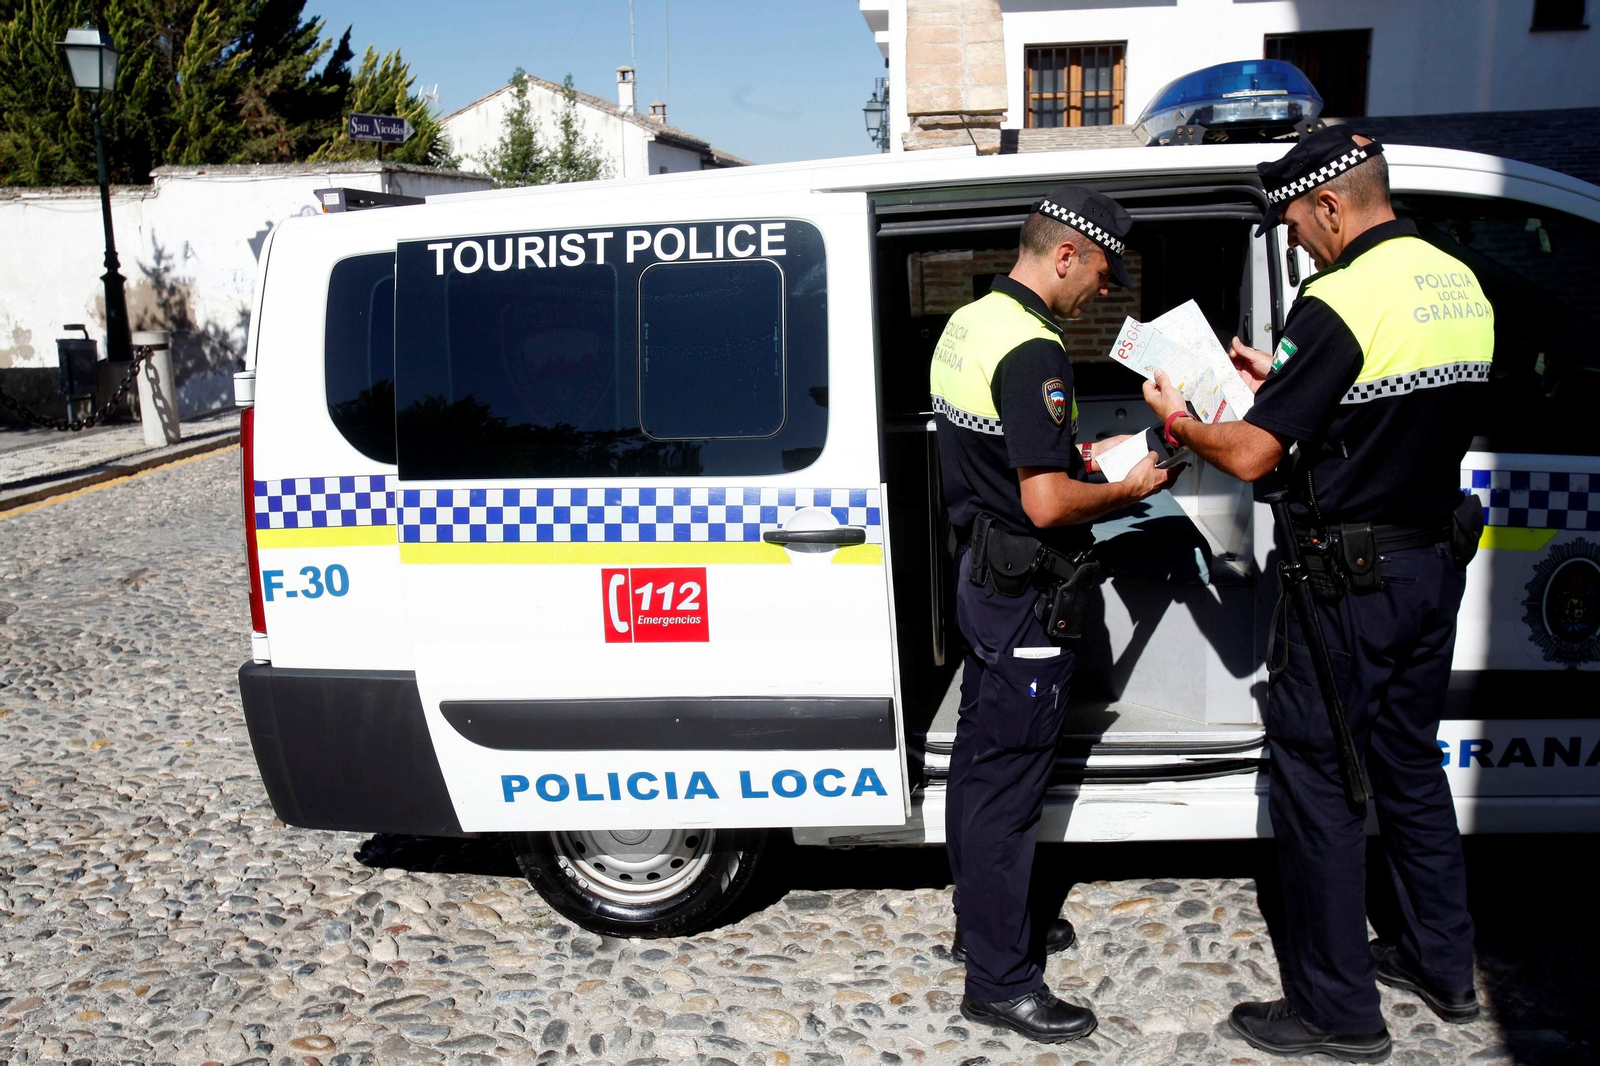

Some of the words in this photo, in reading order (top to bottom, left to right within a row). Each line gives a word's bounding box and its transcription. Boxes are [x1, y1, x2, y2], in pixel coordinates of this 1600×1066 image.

[350, 116, 369, 134] San
[427, 231, 613, 276] TOURIST
[626, 222, 787, 264] POLICE
[1413, 272, 1475, 291] POLICIA
[1437, 290, 1469, 301] LOCAL
[1413, 301, 1492, 324] GRANADA
[933, 346, 964, 372] RANADA
[634, 581, 702, 611] 112
[637, 615, 702, 627] Emergencias
[500, 771, 720, 803] POLICIA
[739, 767, 888, 799] LOCA
